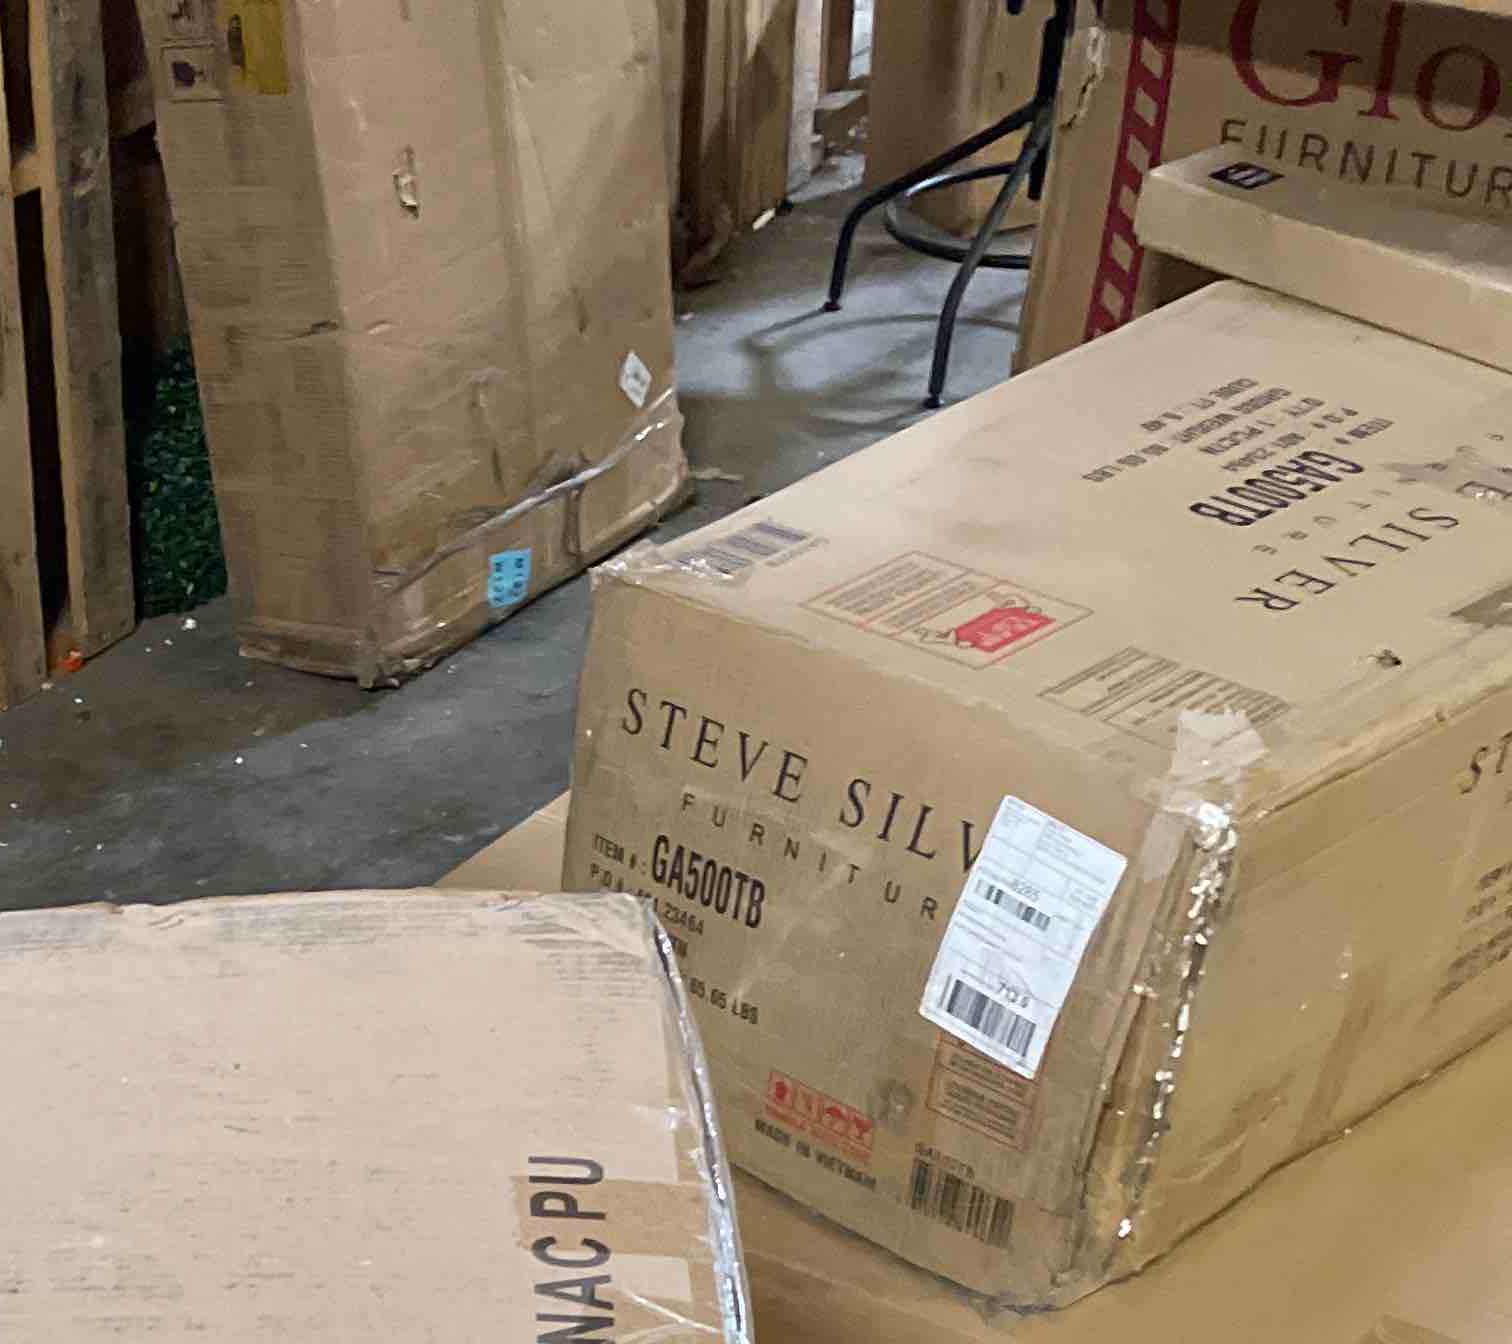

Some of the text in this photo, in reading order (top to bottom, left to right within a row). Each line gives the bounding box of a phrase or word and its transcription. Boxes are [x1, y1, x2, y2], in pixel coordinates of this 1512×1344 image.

[1229, 0, 1512, 139] Glo
[1189, 450, 1364, 527] GA500TB
[1233, 507, 1460, 611] SILVER
[622, 688, 809, 802] STEVE
[592, 834, 624, 864] ITEM
[652, 834, 765, 929] GA500TB
[528, 1156, 608, 1221] PU
